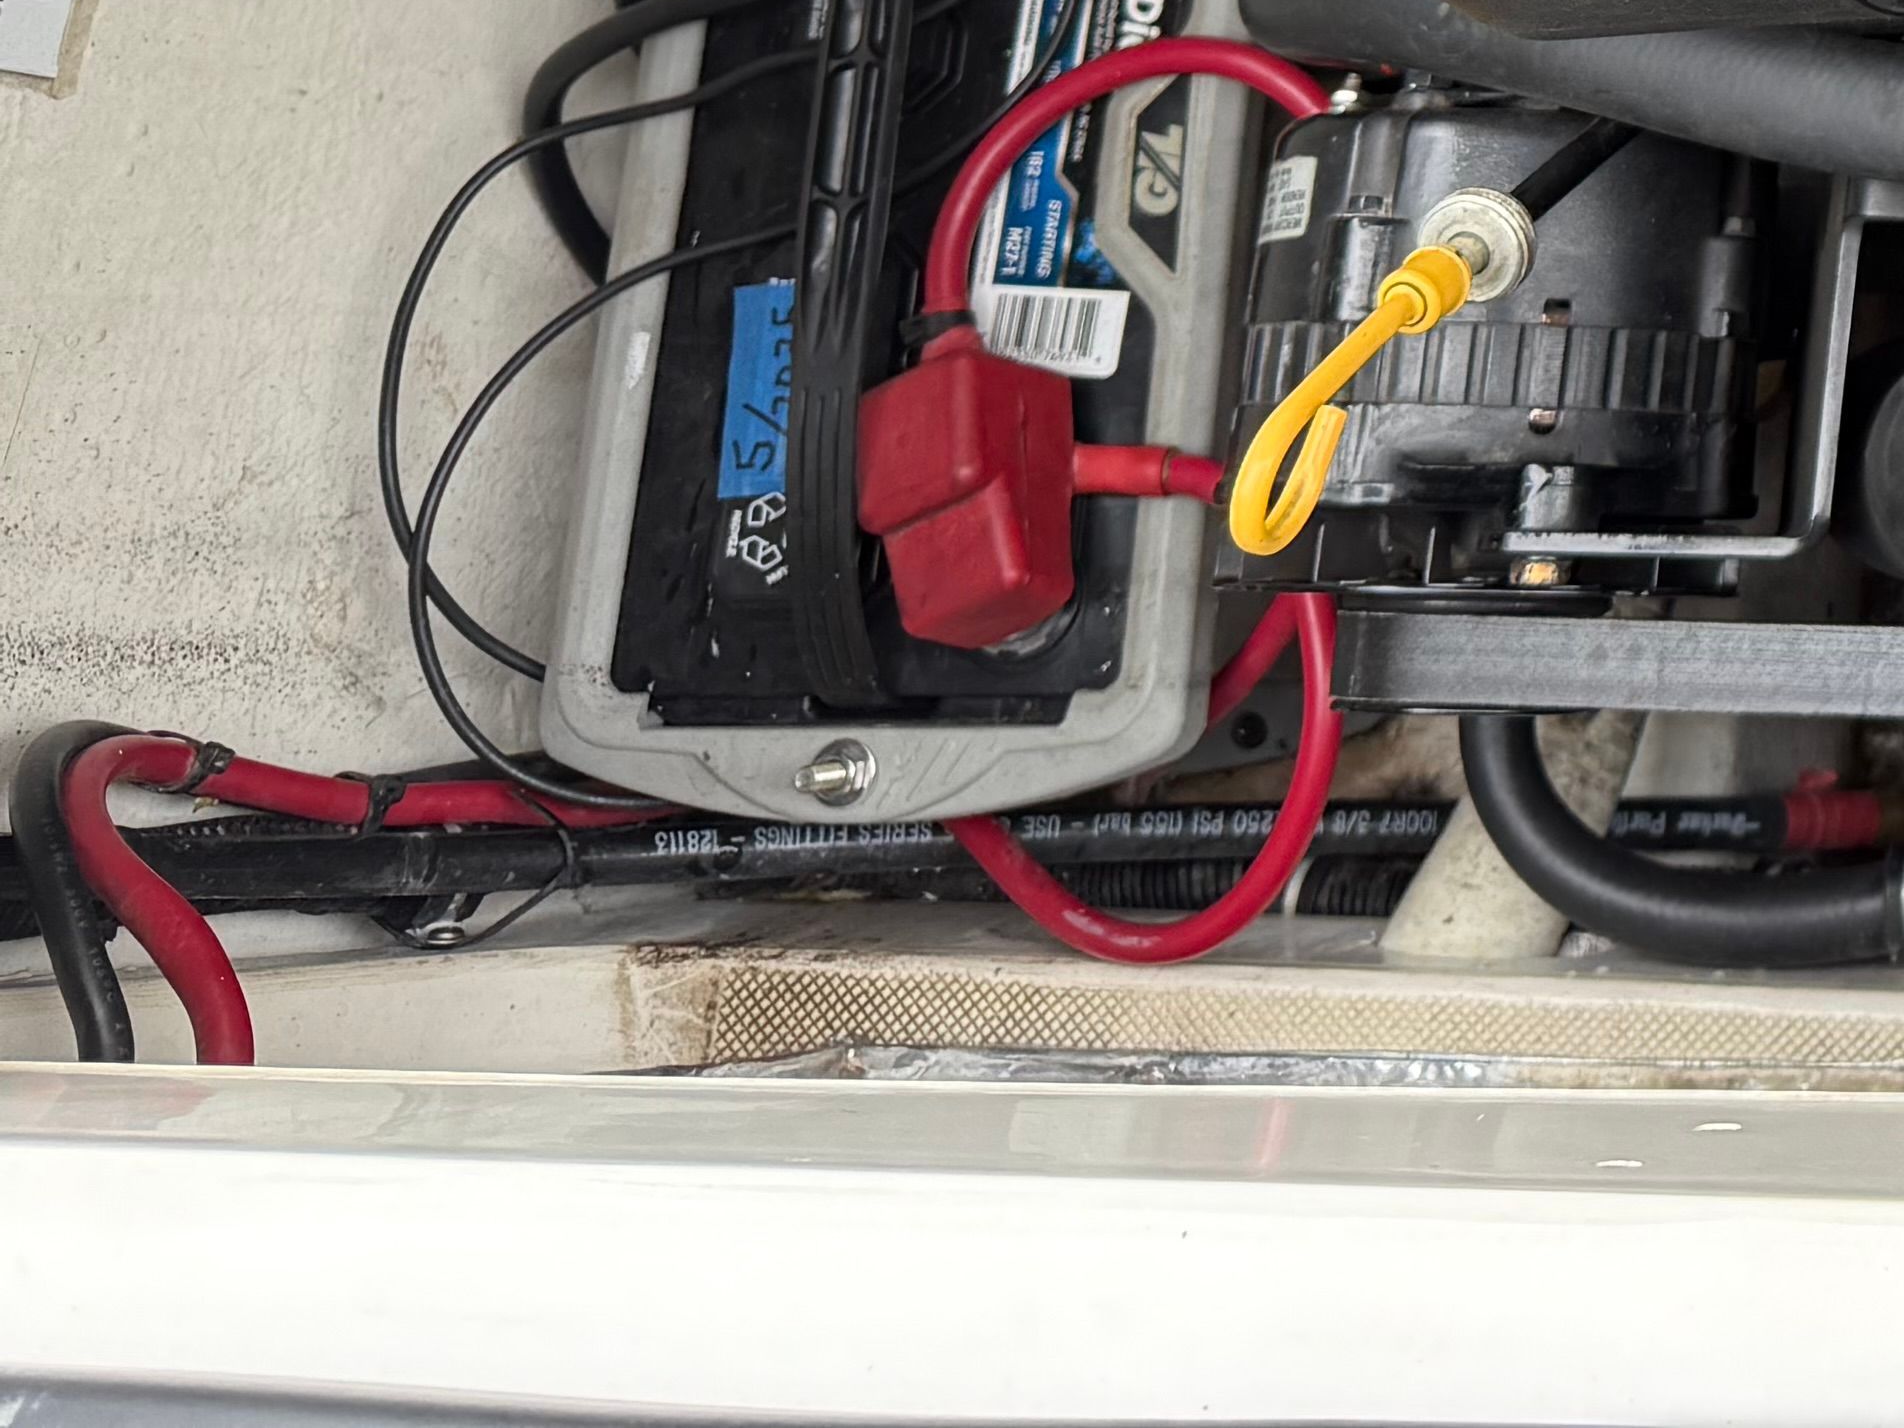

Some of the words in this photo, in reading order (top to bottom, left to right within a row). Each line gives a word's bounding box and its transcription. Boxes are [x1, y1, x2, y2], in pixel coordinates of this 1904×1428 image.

[1034, 198, 1064, 280] STARTING
[1022, 815, 1060, 839] USE
[1093, 811, 1132, 838] bar)
[1193, 808, 1225, 835] PSI
[1235, 808, 1284, 834] 250
[754, 823, 850, 848] FITTINGS
